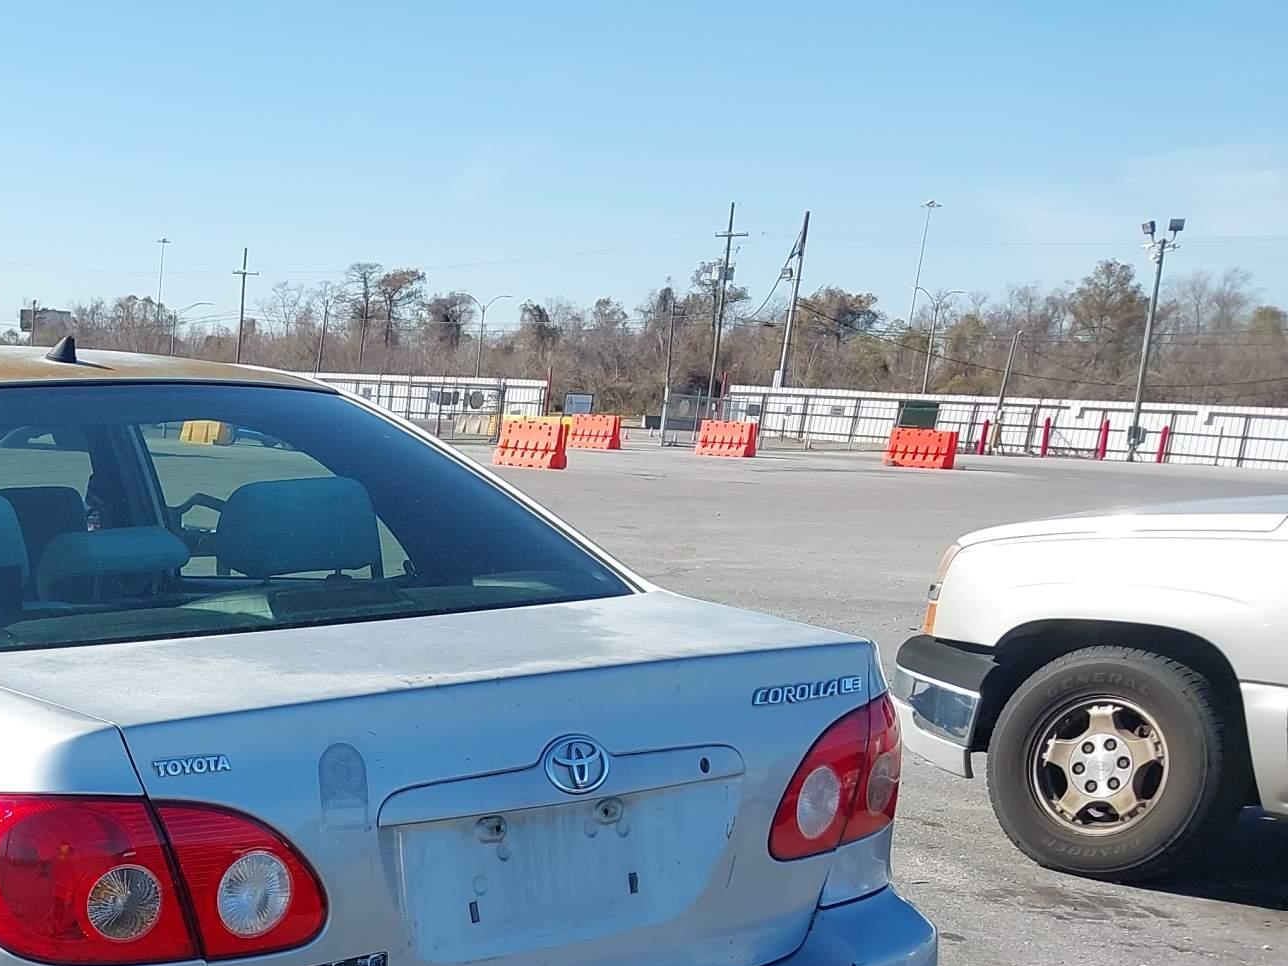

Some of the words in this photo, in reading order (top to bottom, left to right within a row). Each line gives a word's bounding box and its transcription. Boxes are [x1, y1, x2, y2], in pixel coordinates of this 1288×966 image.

[753, 680, 839, 706] COROLLA
[841, 677, 862, 694] LE
[1048, 672, 1152, 697] GENERAL
[153, 755, 231, 777] TOYOTA
